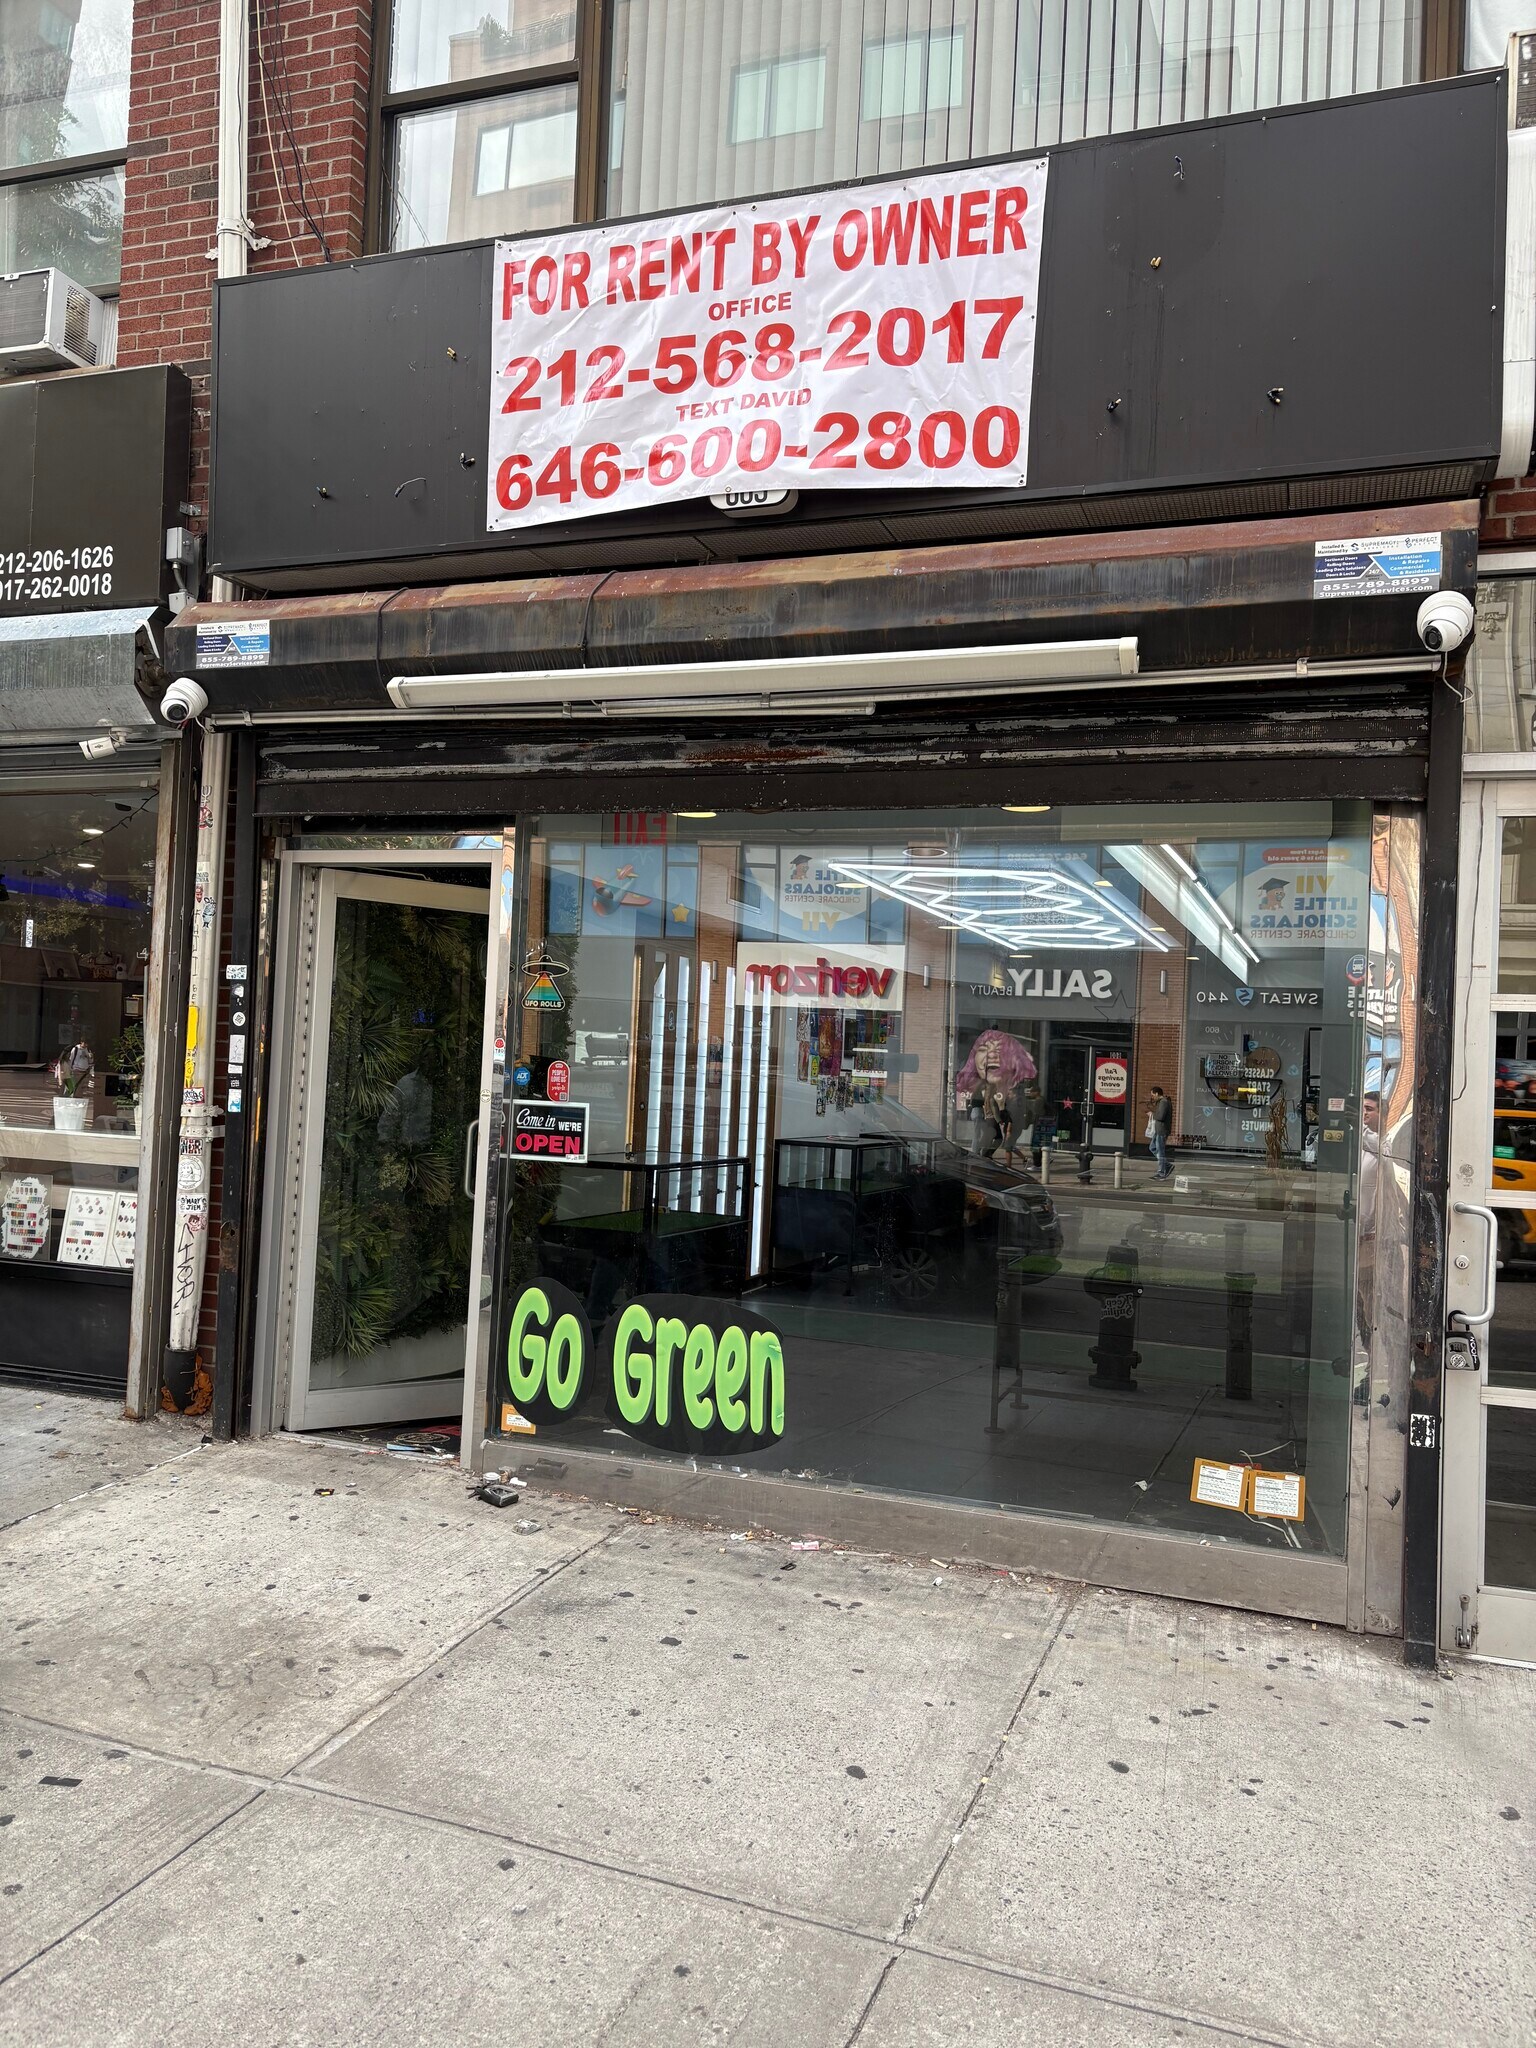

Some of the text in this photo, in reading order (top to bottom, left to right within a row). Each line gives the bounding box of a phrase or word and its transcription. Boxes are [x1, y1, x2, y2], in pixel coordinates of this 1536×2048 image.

[501, 185, 1029, 321] FOR RENT BY OWNER
[708, 292, 792, 321] OFFICE
[500, 296, 1025, 415] 212-568-2017
[675, 387, 812, 422] TEXT DAVID
[495, 405, 1021, 512] 646-600-2800
[0, 572, 112, 600] 17-262-0018
[1319, 585, 1433, 598] SupremacyServices.com
[1322, 577, 1430, 591] 855-789-8899
[202, 655, 264, 663] 855-789-8899
[540, 1000, 562, 1008] ROLLS
[516, 1108, 582, 1132] Come in WE'RE
[516, 1133, 580, 1155] OPEN
[508, 1287, 786, 1437] Go Green
